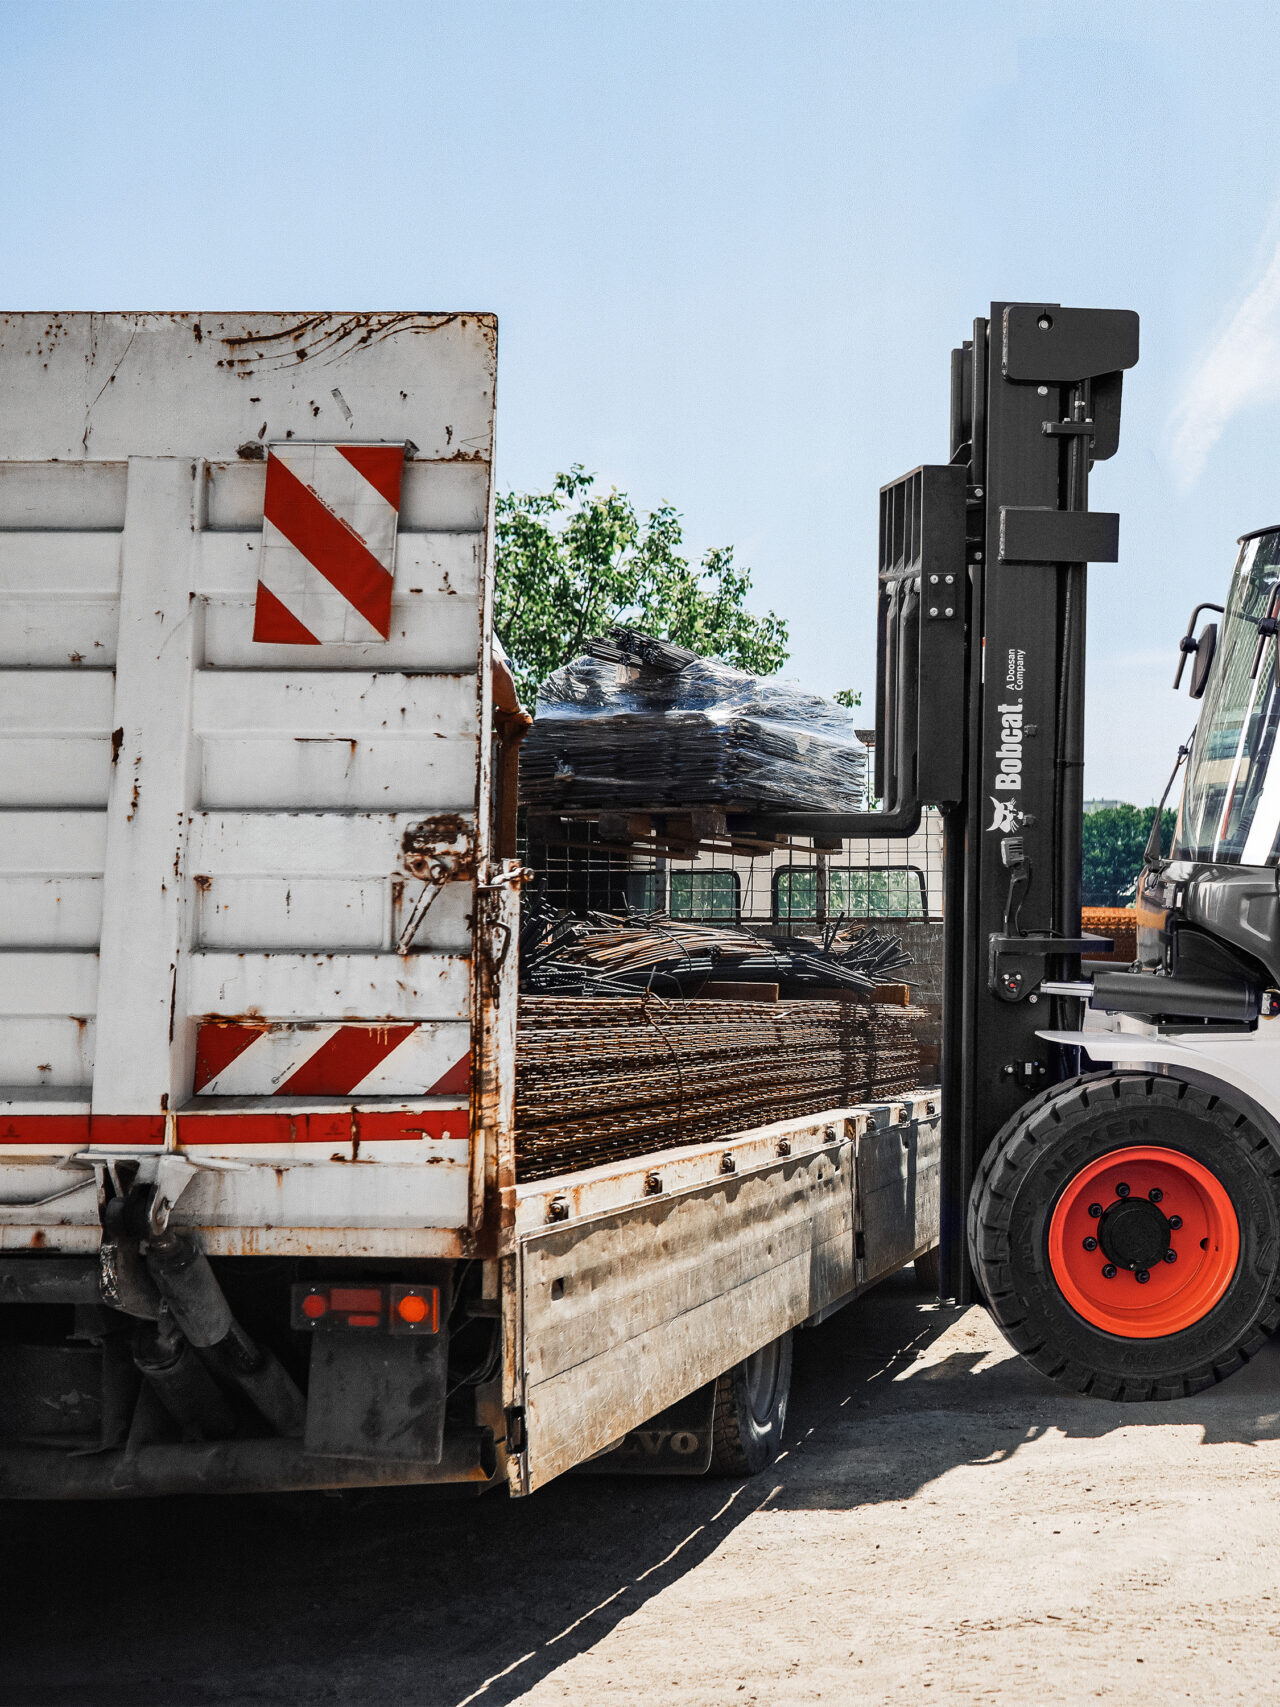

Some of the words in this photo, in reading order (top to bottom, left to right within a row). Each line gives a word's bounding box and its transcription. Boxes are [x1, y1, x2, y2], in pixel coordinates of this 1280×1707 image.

[1006, 648, 1015, 681] Doosan
[1014, 649, 1026, 691] Company
[1006, 682, 1015, 690] A
[995, 703, 1023, 790] Bobcat
[1044, 1118, 1149, 1180] NEXEN
